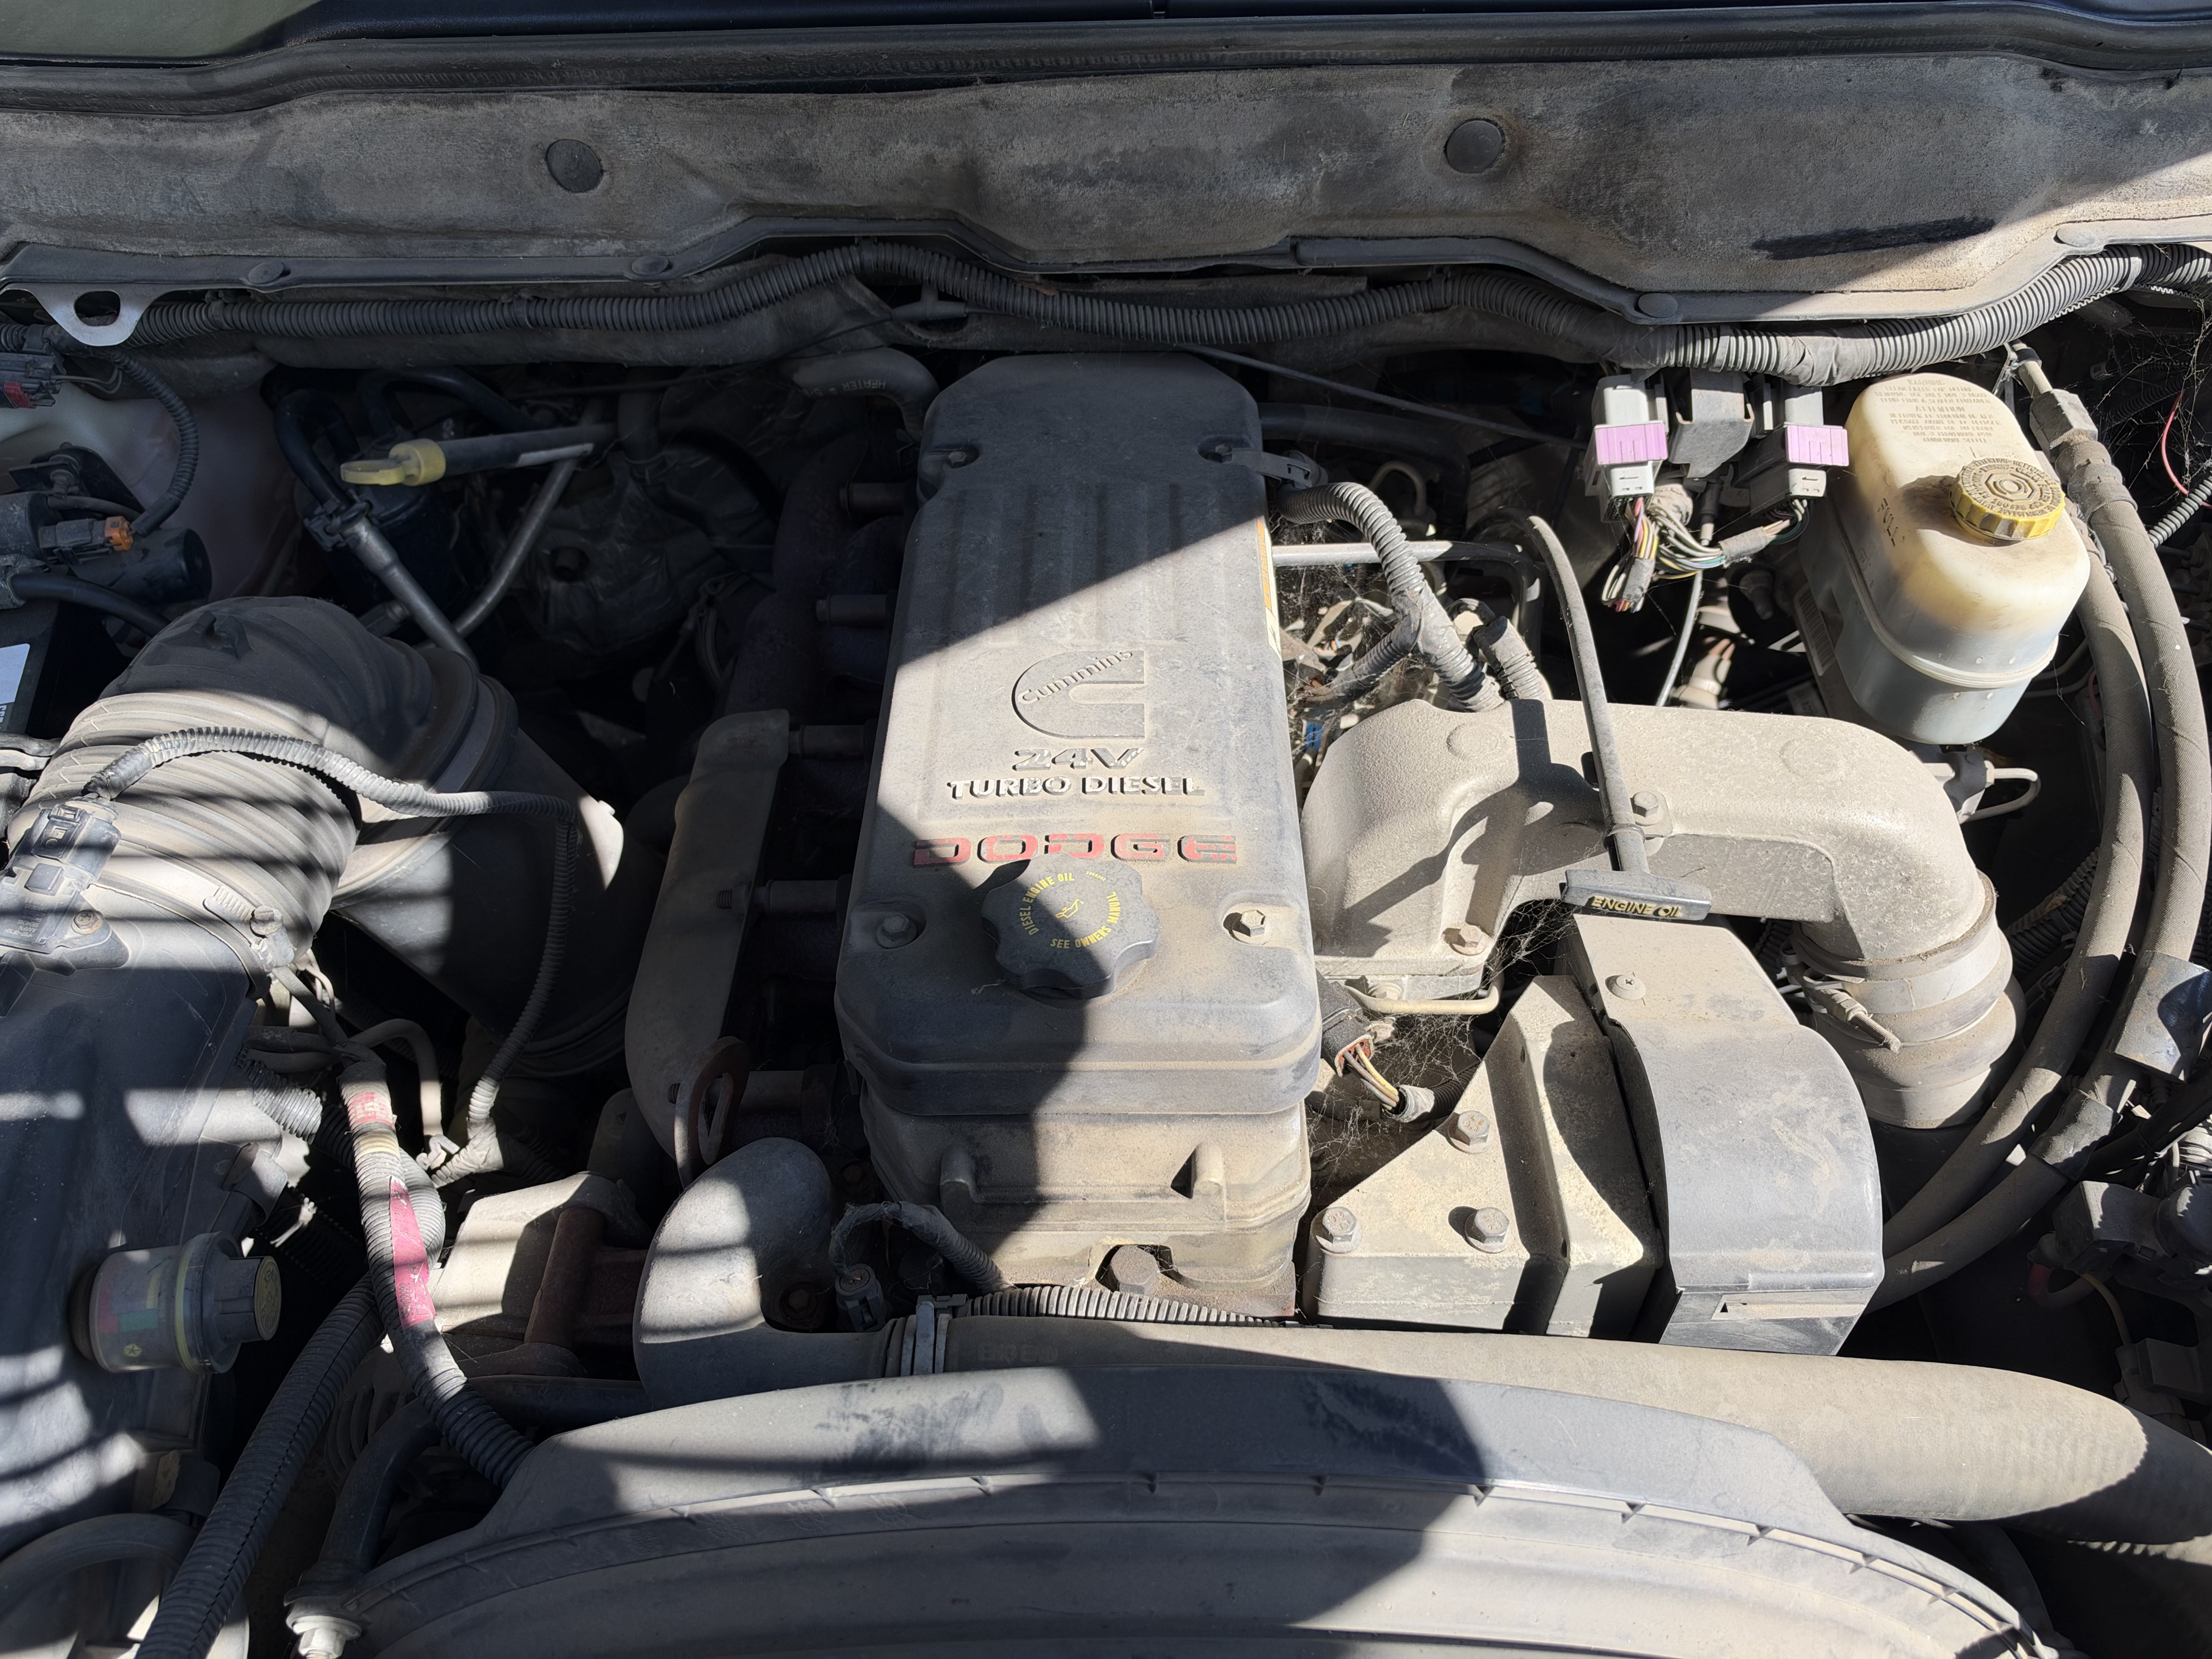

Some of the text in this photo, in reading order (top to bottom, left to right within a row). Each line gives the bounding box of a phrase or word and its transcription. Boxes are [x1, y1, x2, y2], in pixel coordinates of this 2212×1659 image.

[1018, 650, 1133, 704] Cummins
[1012, 747, 1144, 771] 24V
[947, 776, 1205, 800] TURBO DIESEL
[914, 833, 1237, 865] DODGE
[1020, 872, 1075, 936] DIESEL ENGINE OIL
[1050, 891, 1120, 948] SEE OWNERS MANUAL
[1590, 895, 1683, 918] ENGINE OIL
